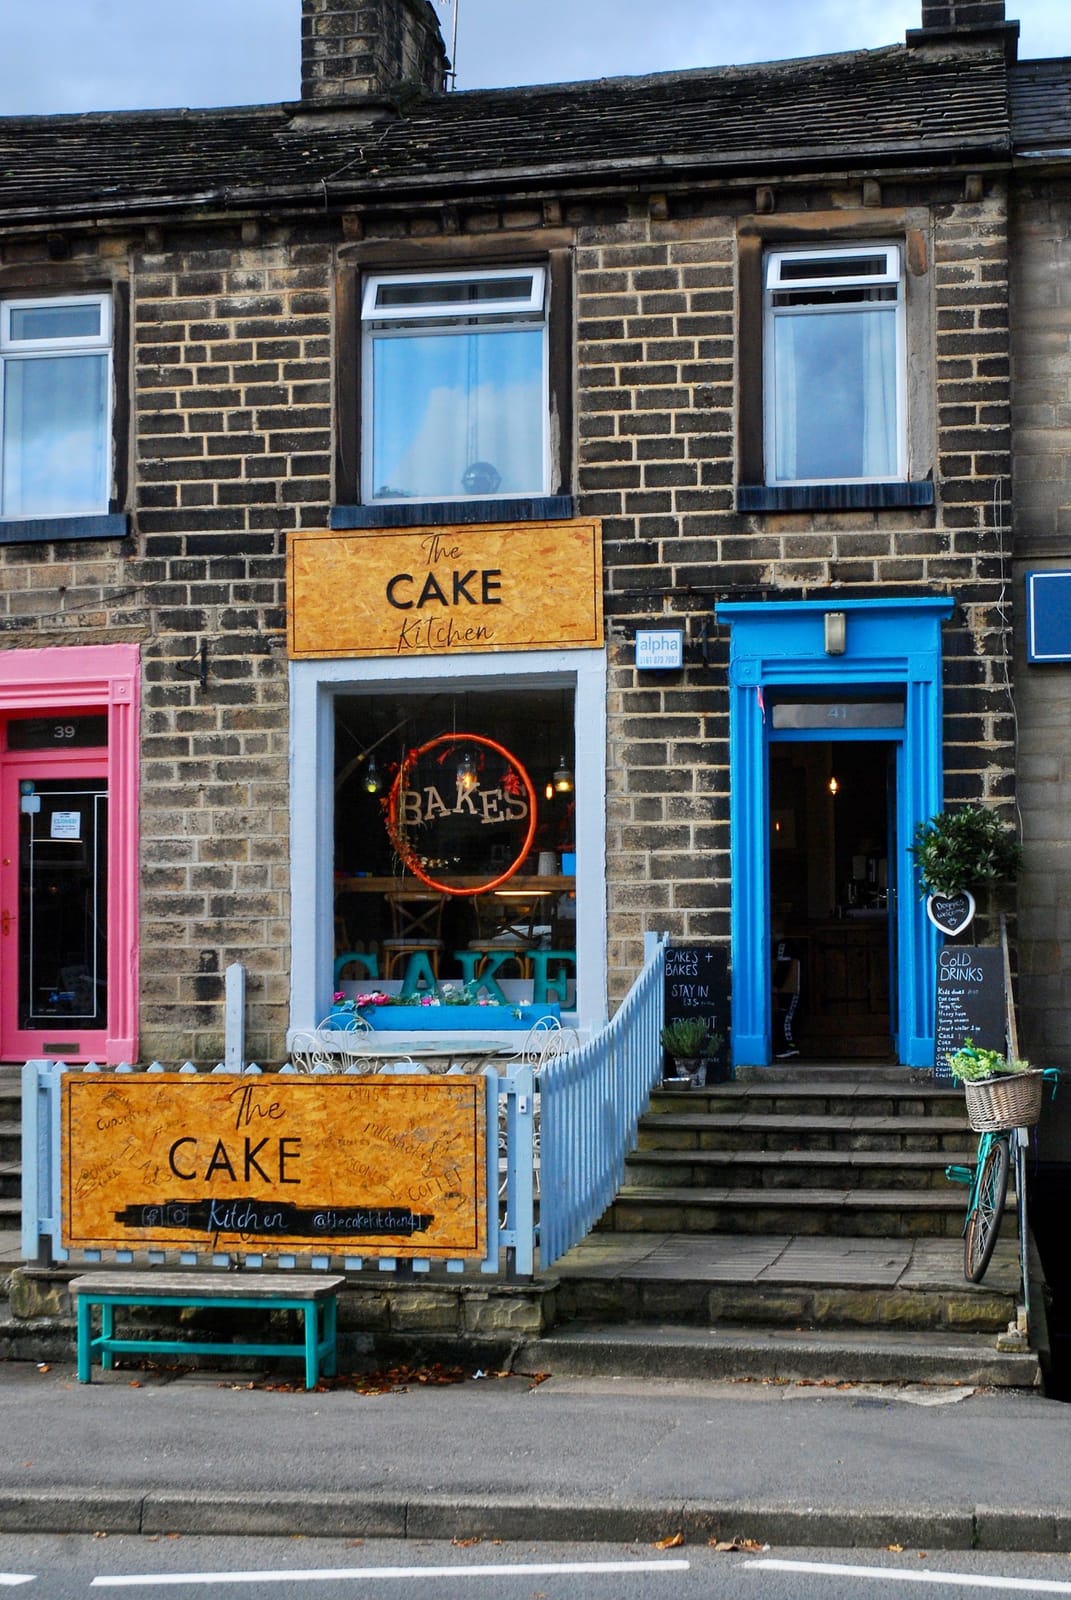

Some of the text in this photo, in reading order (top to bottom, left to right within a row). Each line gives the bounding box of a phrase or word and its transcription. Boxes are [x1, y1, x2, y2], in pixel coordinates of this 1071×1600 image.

[421, 533, 463, 566] The
[386, 569, 502, 610] CAKE
[397, 616, 495, 653] Kitchen
[640, 636, 678, 654] alpha
[827, 707, 848, 719] 41
[54, 726, 76, 738] 39
[400, 779, 528, 826] BAKES
[665, 963, 698, 976] BAKES
[666, 950, 698, 963] CAKES
[334, 950, 577, 1008] CAKE
[940, 967, 984, 981] DRINKS
[672, 984, 709, 998] STAY IN
[229, 1083, 286, 1130] The
[168, 1136, 301, 1184] CAKE
[207, 1197, 289, 1233] Kitchen
